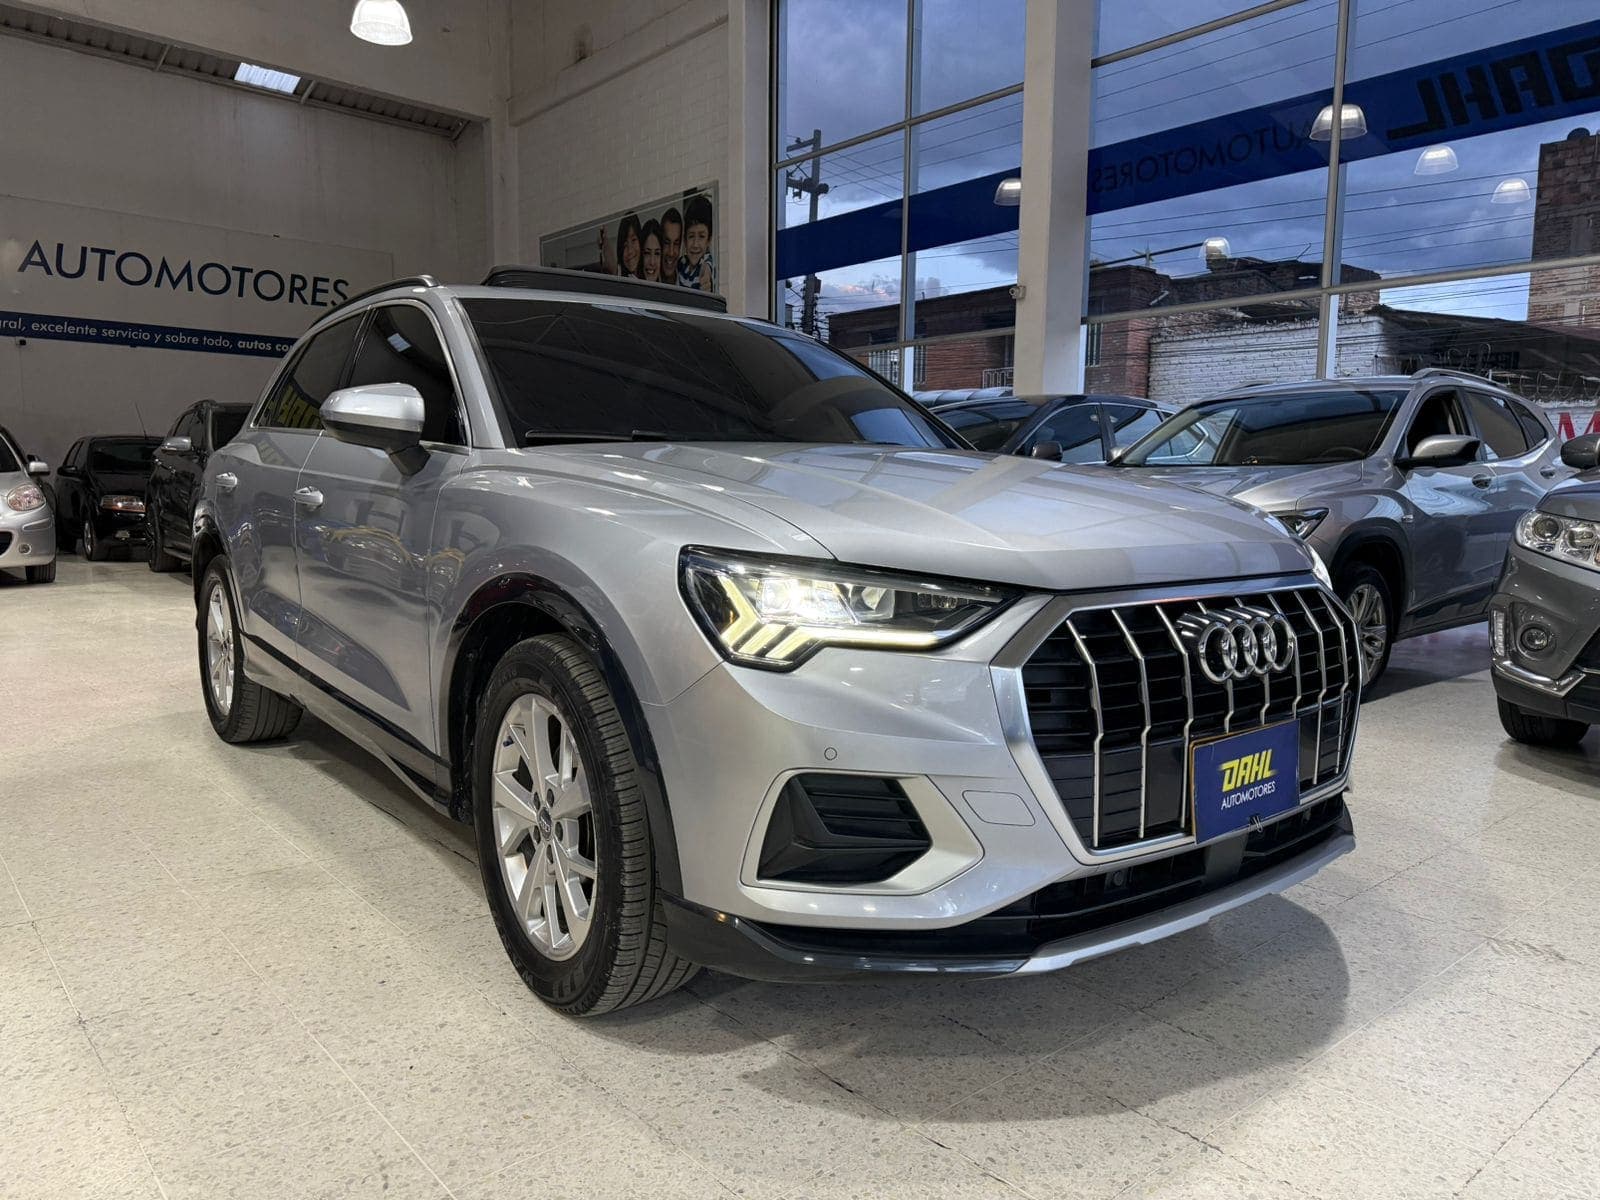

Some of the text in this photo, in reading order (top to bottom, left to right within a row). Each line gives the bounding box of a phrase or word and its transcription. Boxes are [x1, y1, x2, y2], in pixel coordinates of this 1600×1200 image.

[17, 239, 350, 308] AUTOMOTORES
[0, 317, 26, 332] ral,
[31, 321, 97, 336] excelente
[101, 327, 151, 341] servicio
[154, 333, 161, 345] y
[165, 332, 199, 345] sobre
[202, 335, 233, 350] todo,
[237, 339, 272, 352] autos
[1219, 748, 1278, 792] DAHL
[1220, 780, 1276, 811] AUTOMOTORES
